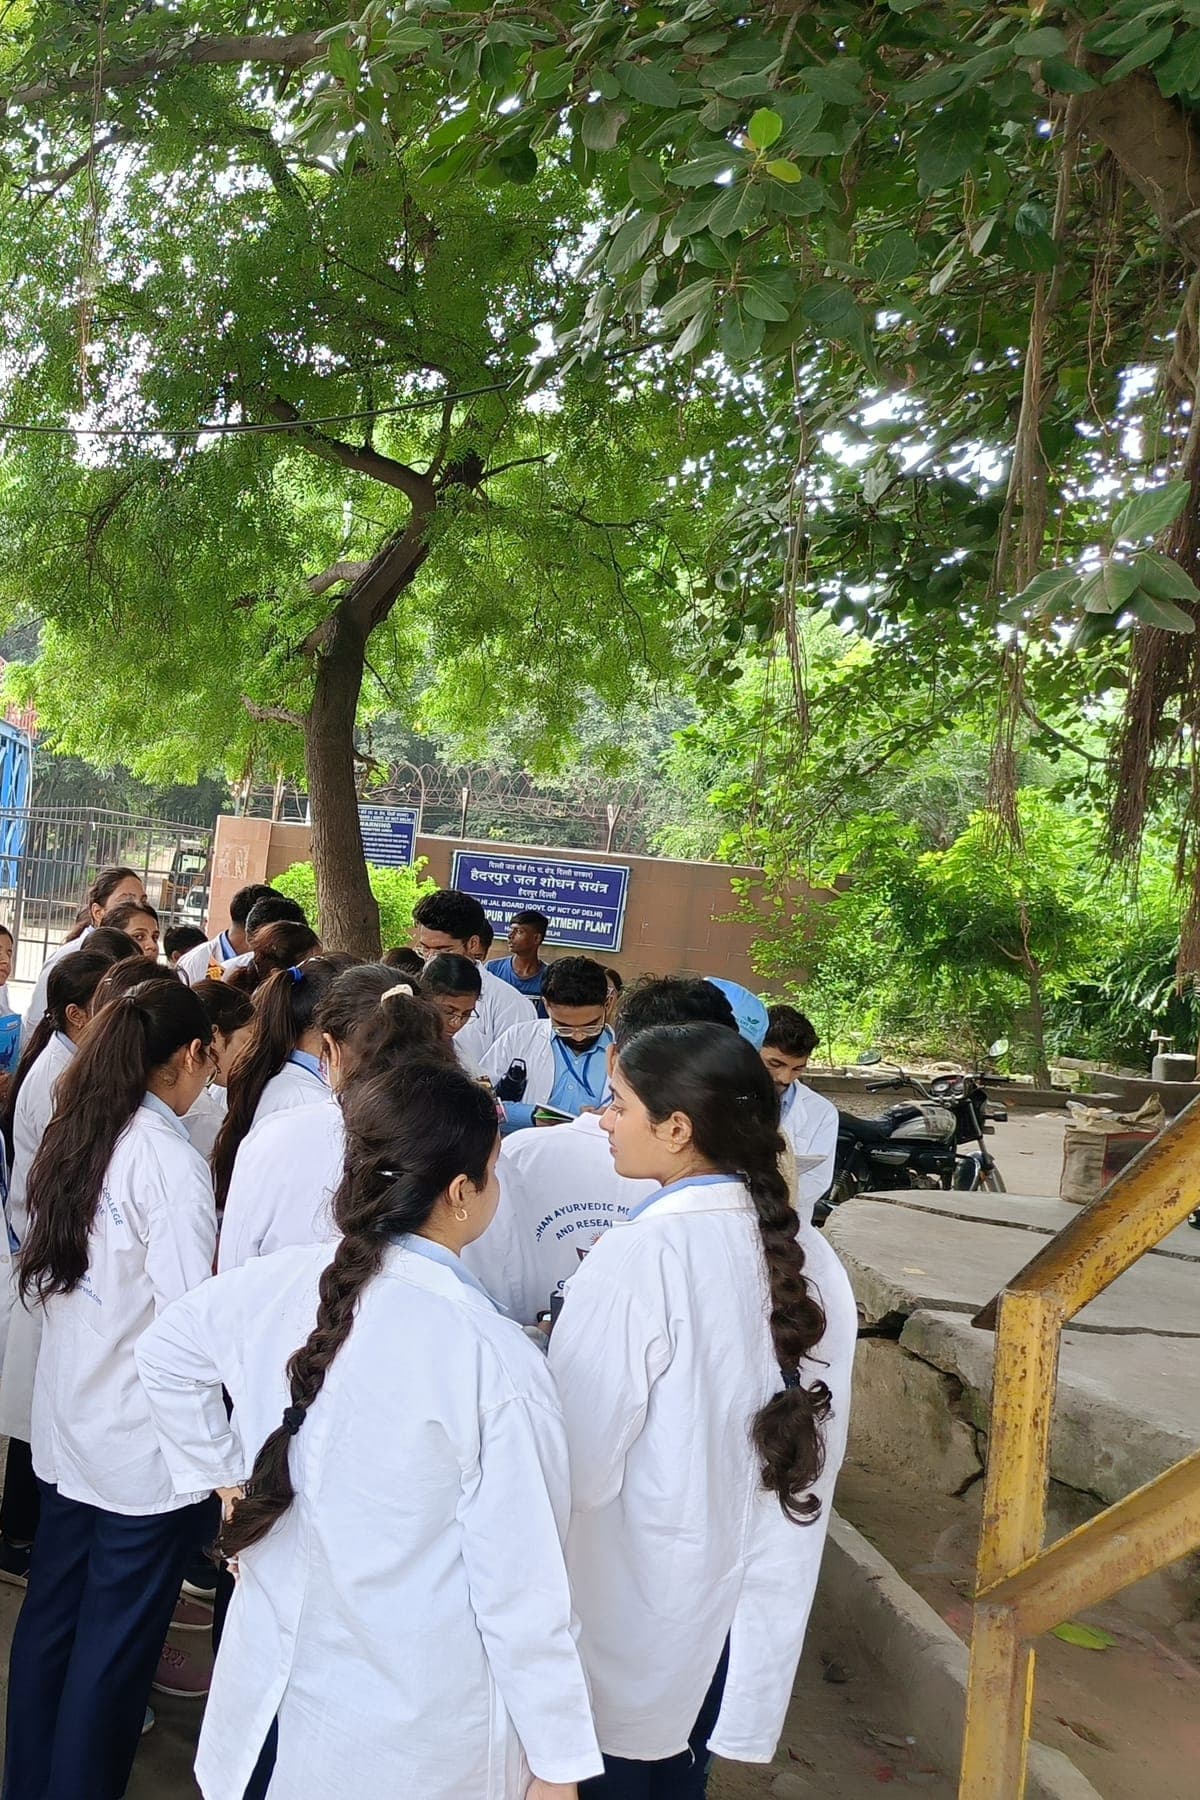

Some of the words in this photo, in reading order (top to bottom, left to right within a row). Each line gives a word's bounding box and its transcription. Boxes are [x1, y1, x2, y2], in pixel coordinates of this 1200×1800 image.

[470, 866, 511, 886] हैदरपुर
[513, 874, 537, 886] जल
[539, 875, 576, 890] शोधन
[501, 901, 525, 910] BOARD
[546, 905, 557, 913] OF
[557, 906, 571, 914] NCT
[571, 908, 580, 916] OF
[581, 909, 603, 919] DELHI)
[546, 915, 584, 931] ATMENT
[584, 920, 613, 934] PLANT
[103, 1187, 124, 1226] COLLEGE
[536, 1215, 553, 1243] SHAN
[554, 1202, 614, 1219] AYURVEDIC
[555, 1224, 575, 1241] AND
[577, 1219, 613, 1230] RESEA
